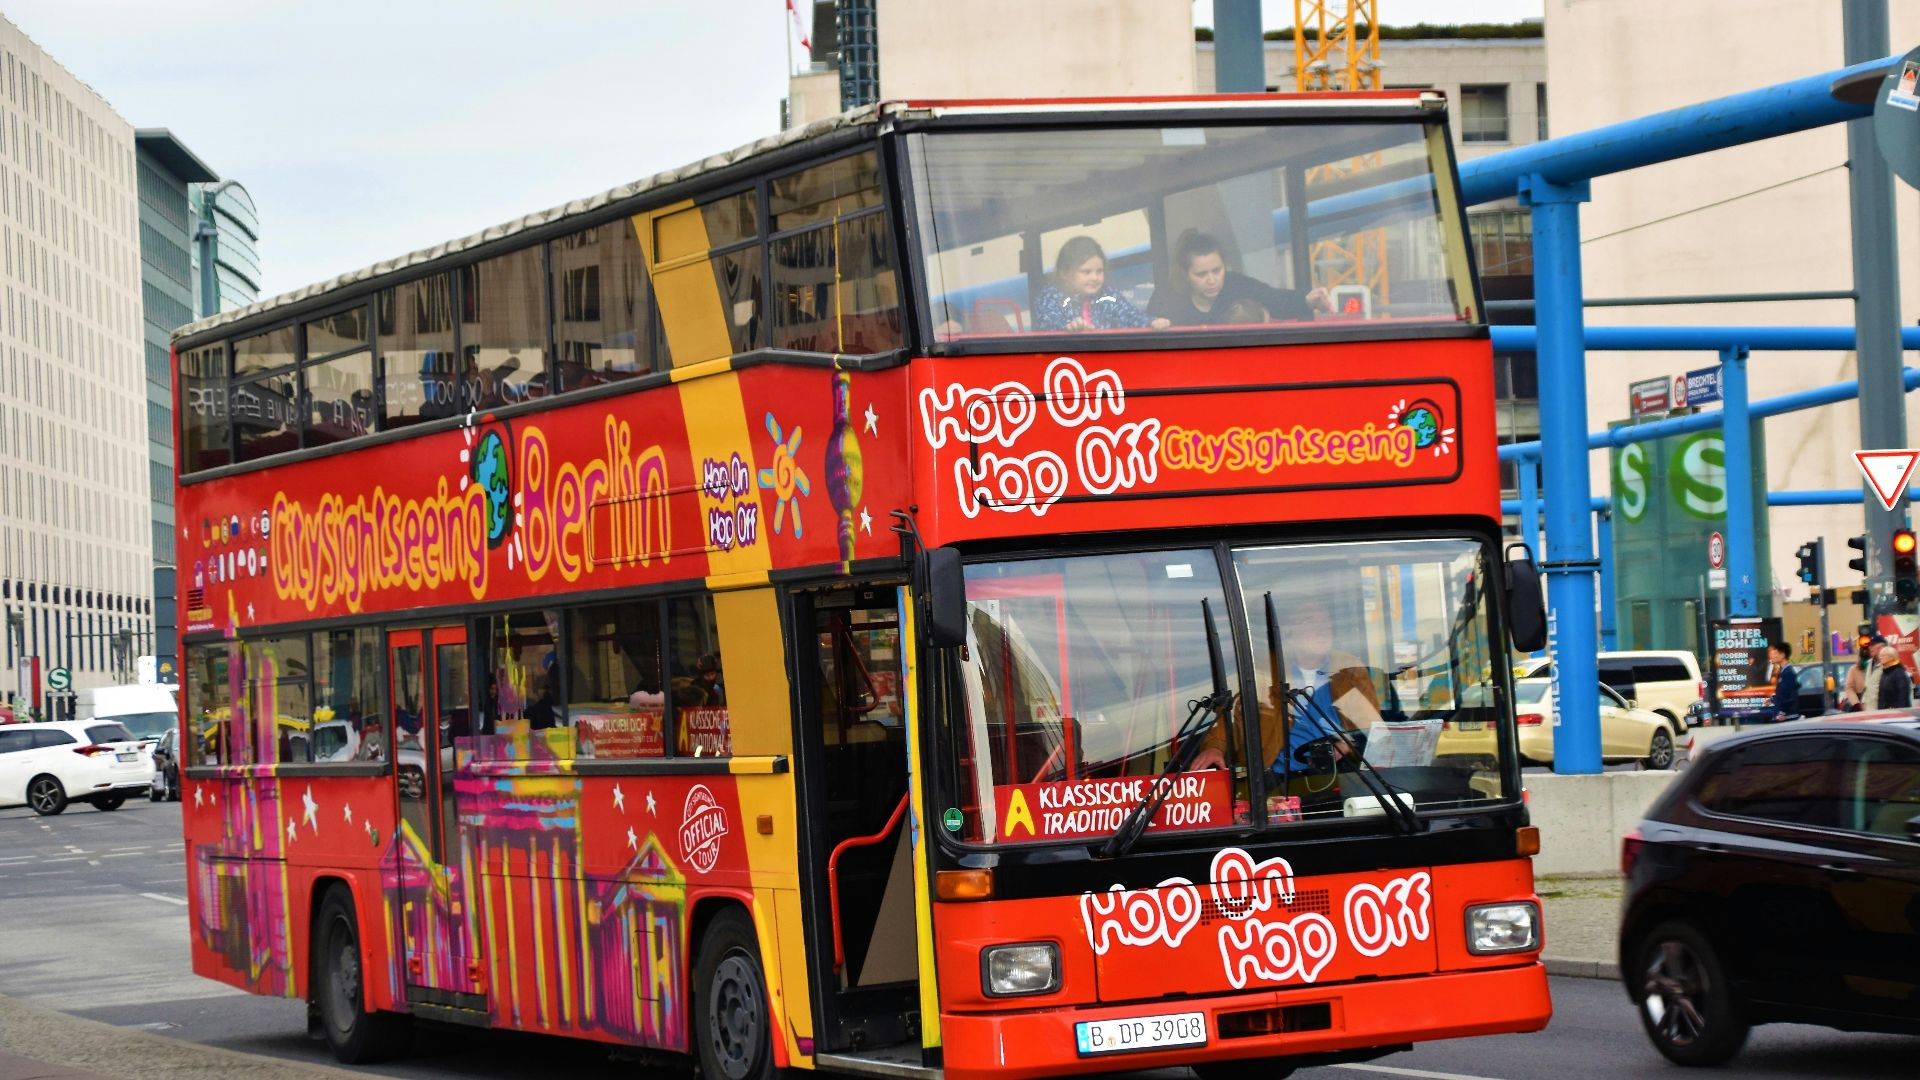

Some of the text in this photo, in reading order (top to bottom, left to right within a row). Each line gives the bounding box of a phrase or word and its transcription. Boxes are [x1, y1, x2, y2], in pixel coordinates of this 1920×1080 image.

[919, 357, 1126, 449] Hop On
[703, 451, 750, 503] Hop On
[954, 418, 1162, 518] Hop Off
[1620, 442, 1647, 519] S
[1683, 437, 1727, 515] S
[520, 413, 672, 582] Berlin
[709, 501, 758, 552] Hop Off
[1716, 629, 1762, 640] DIETER
[1716, 638, 1768, 649] BOHLEN
[1719, 652, 1749, 660] MODERN
[51, 668, 69, 689] S
[679, 710, 689, 752] A
[1005, 788, 1036, 837] A
[1040, 780, 1144, 810] KLASSISCHE
[1165, 801, 1212, 826] TOUR
[684, 811, 726, 853] OFFICIAL
[698, 842, 717, 866] TOUR
[1079, 847, 1295, 956] Hop On
[1217, 871, 1432, 990] Hop Off
[1091, 1017, 1201, 1047] B DP 3908
